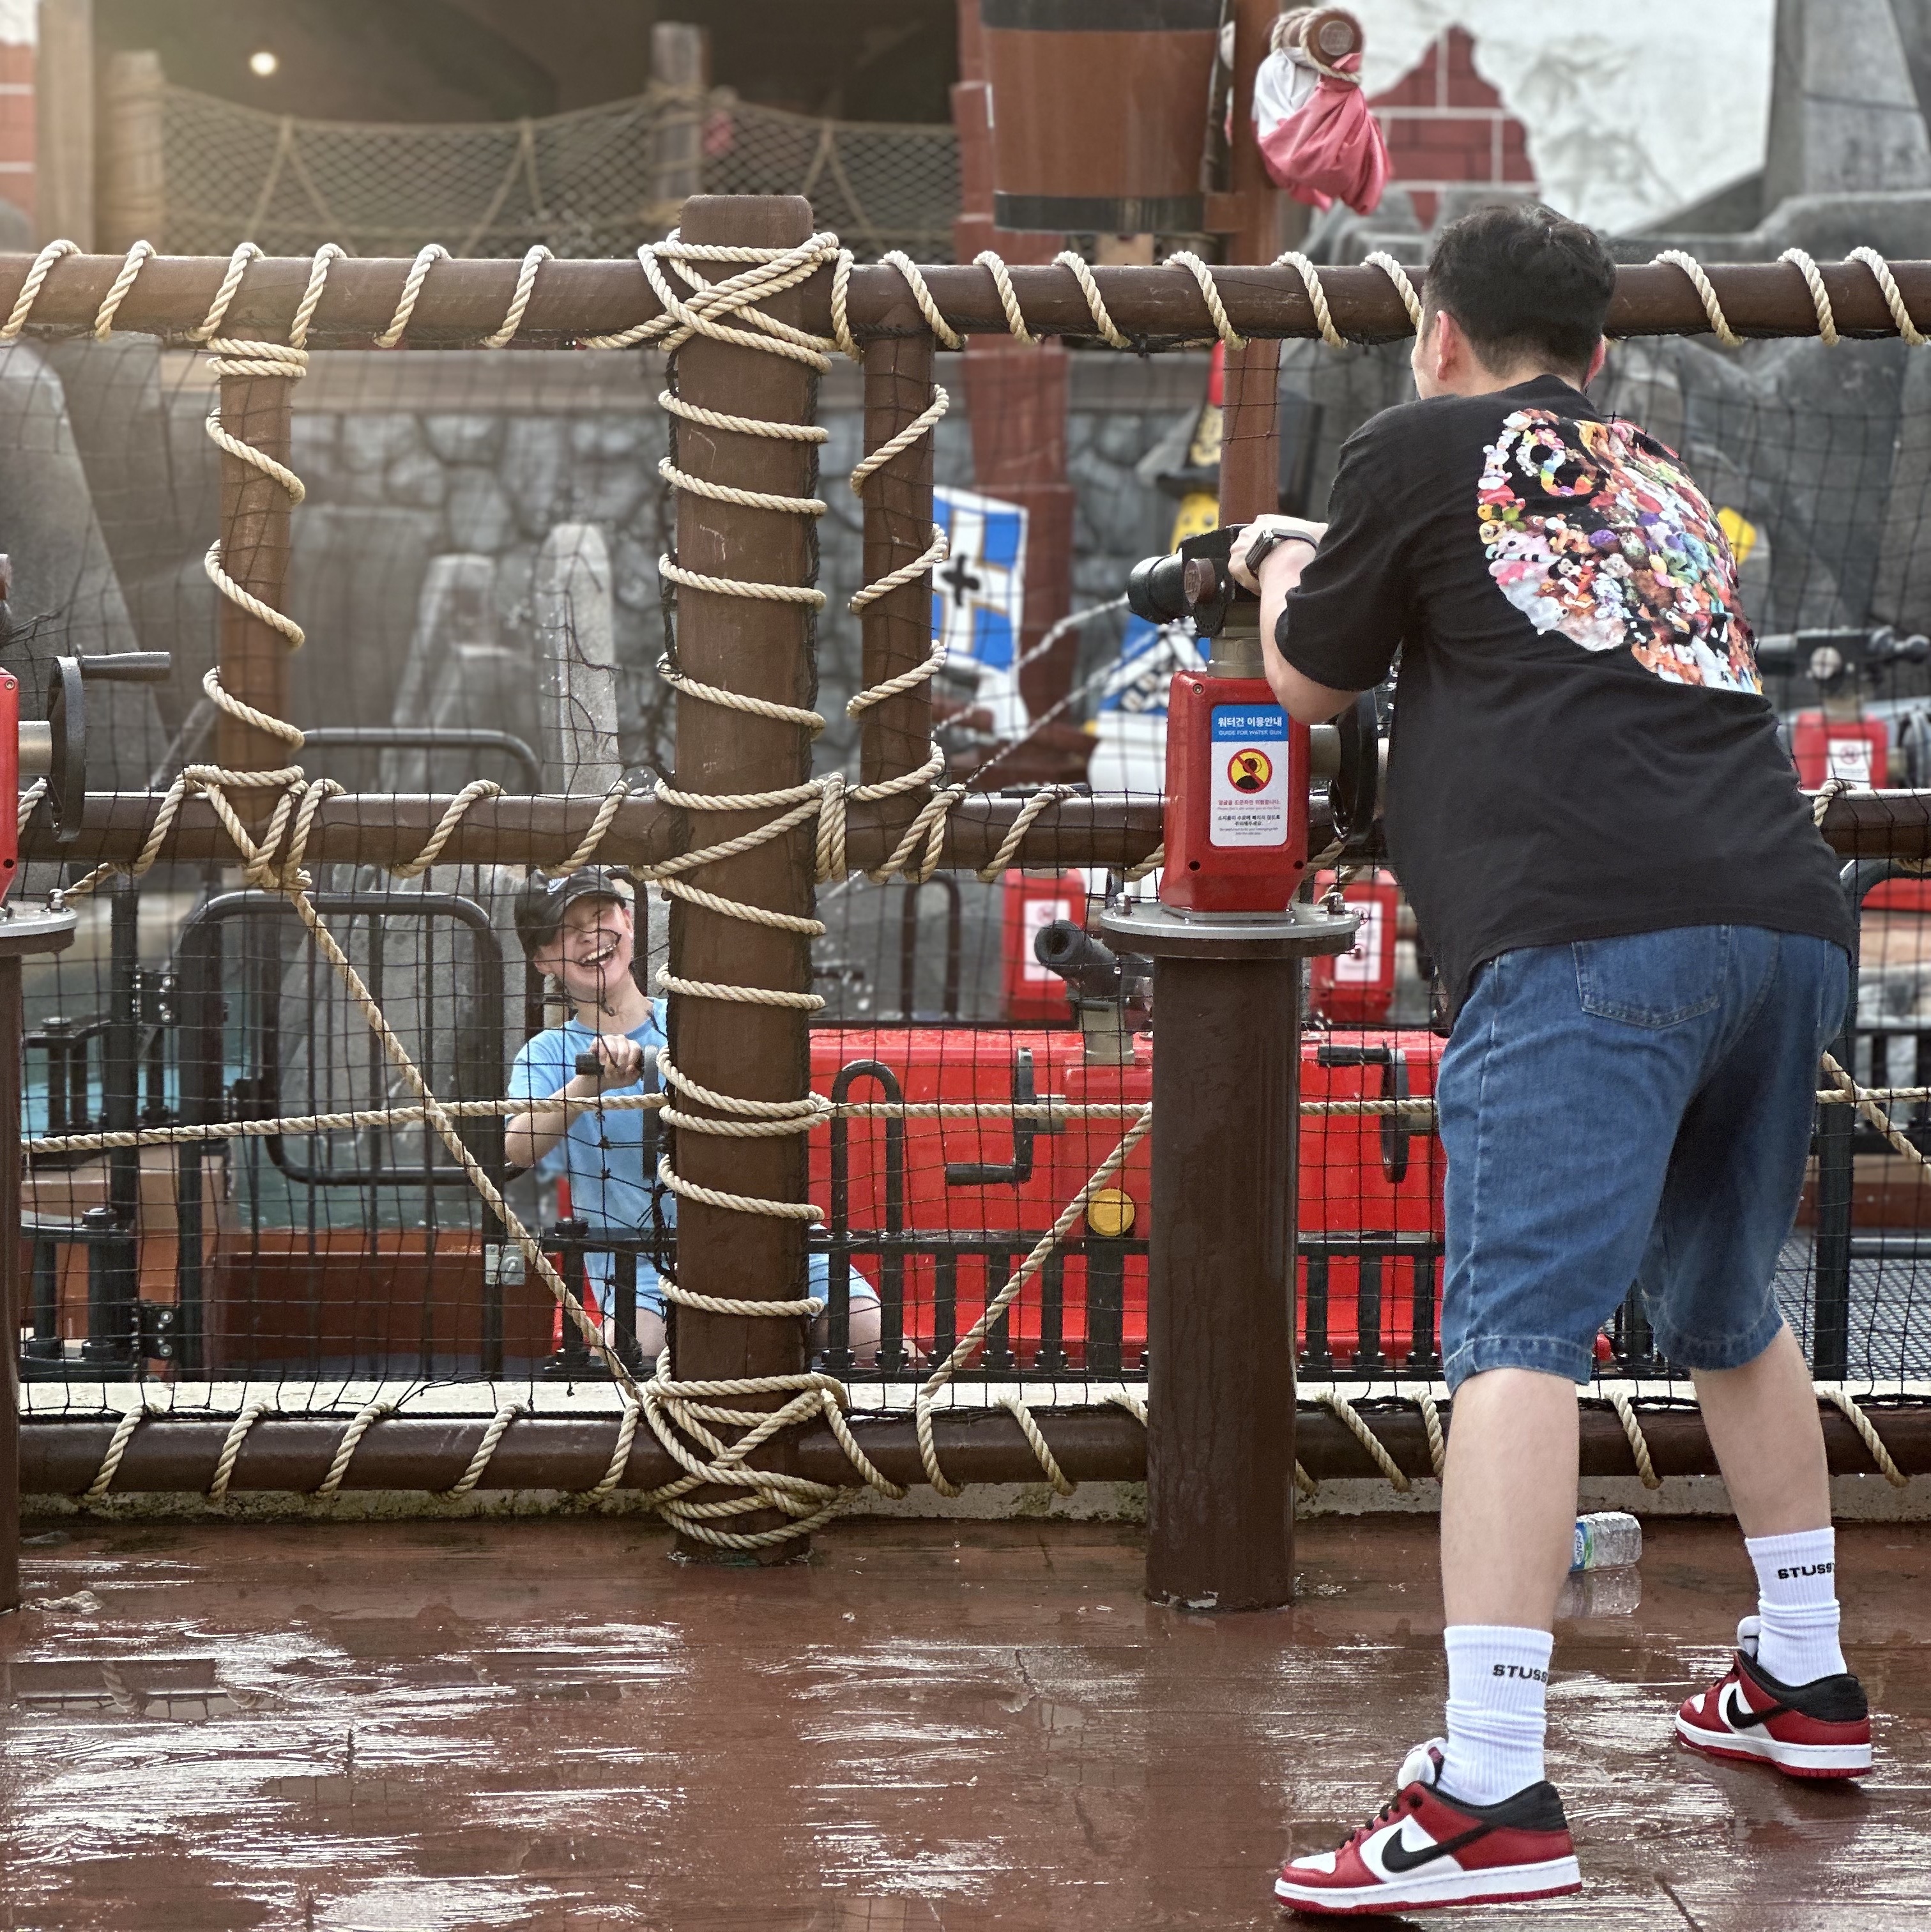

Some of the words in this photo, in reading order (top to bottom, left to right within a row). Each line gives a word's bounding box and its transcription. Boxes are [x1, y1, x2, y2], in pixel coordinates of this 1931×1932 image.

[1218, 717, 1245, 727] 워터건
[1247, 716, 1282, 727] 이용안내
[1778, 1562, 1834, 1579] STUSS
